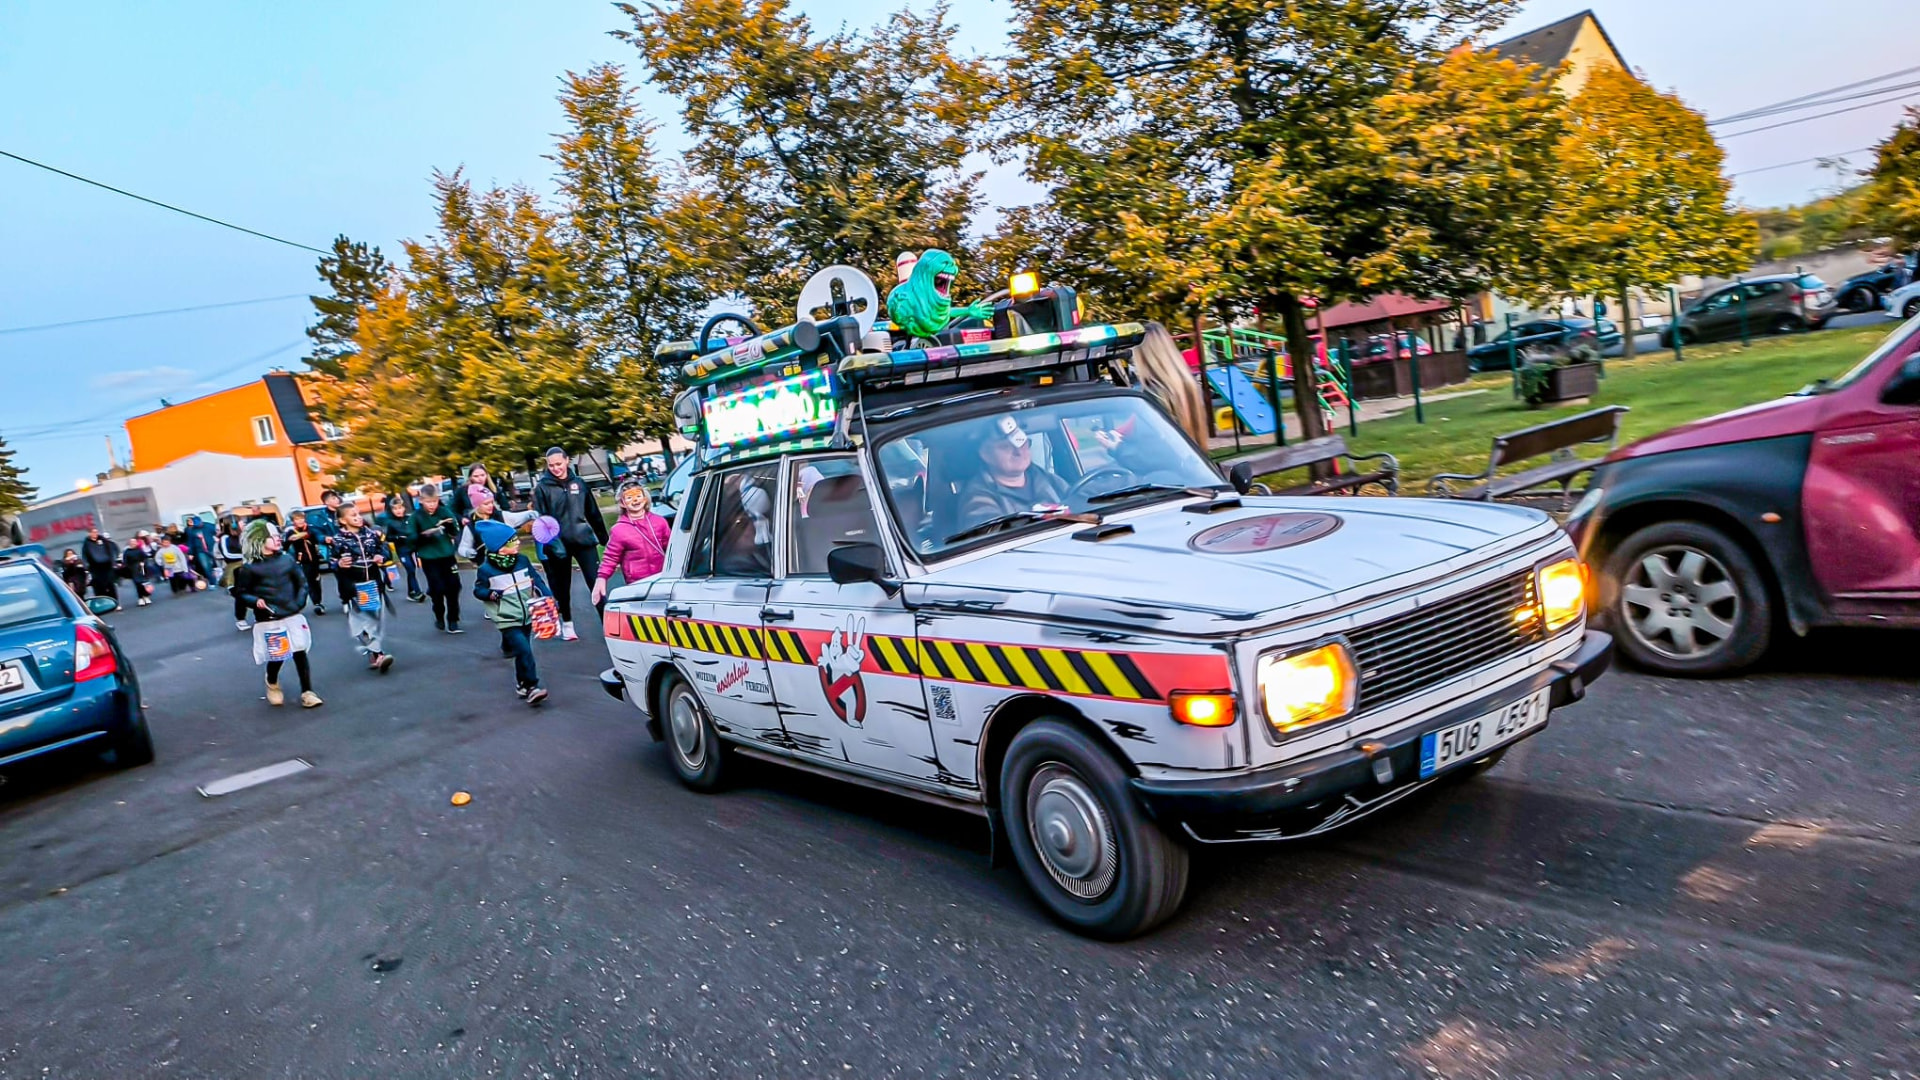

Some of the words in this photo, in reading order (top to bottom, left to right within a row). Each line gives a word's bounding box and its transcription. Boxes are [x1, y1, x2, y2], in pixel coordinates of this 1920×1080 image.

[695, 671, 717, 683] MUZEUM
[716, 661, 750, 693] nostalgie
[744, 681, 770, 694] TEREZÍN
[1440, 721, 1482, 762] 5U8
[1495, 693, 1541, 737] 4591
